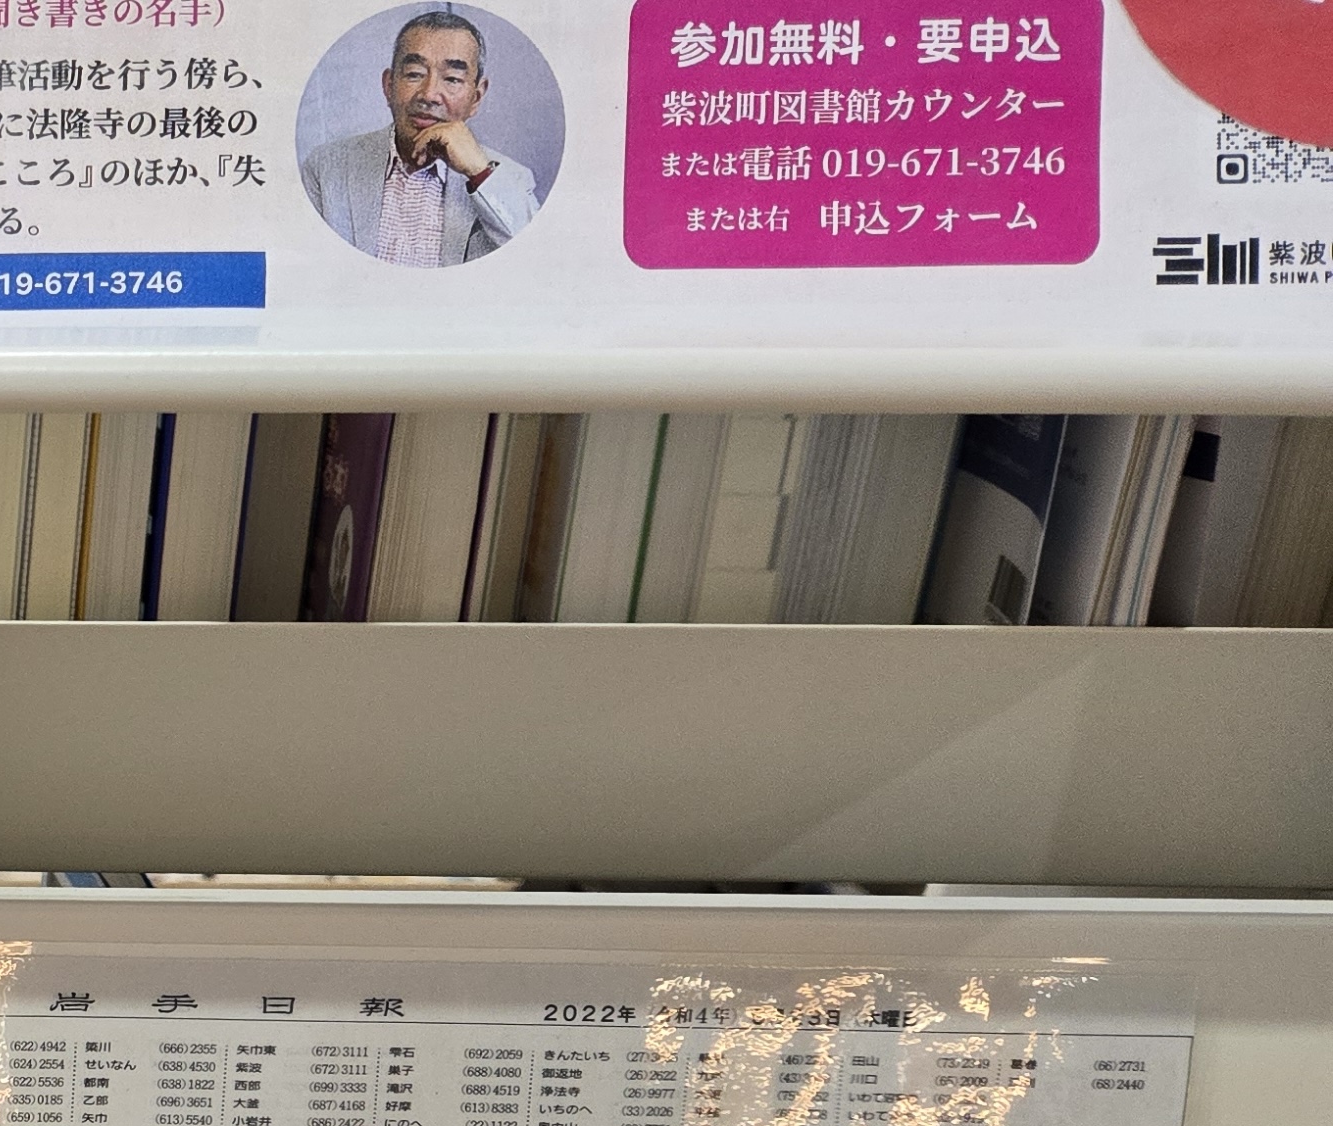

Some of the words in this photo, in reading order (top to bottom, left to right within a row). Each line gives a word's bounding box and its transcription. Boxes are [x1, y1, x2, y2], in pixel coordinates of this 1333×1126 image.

[670, 18, 1062, 68] 参加無料・要申込
[662, 89, 1065, 127] 紫波町図書館カウンター
[661, 146, 812, 182] または電話
[821, 147, 1066, 178] 019-671-3746
[686, 206, 790, 233] または右
[820, 200, 1038, 235] 申込フォーム
[1270, 271, 1319, 285] SHIWA
